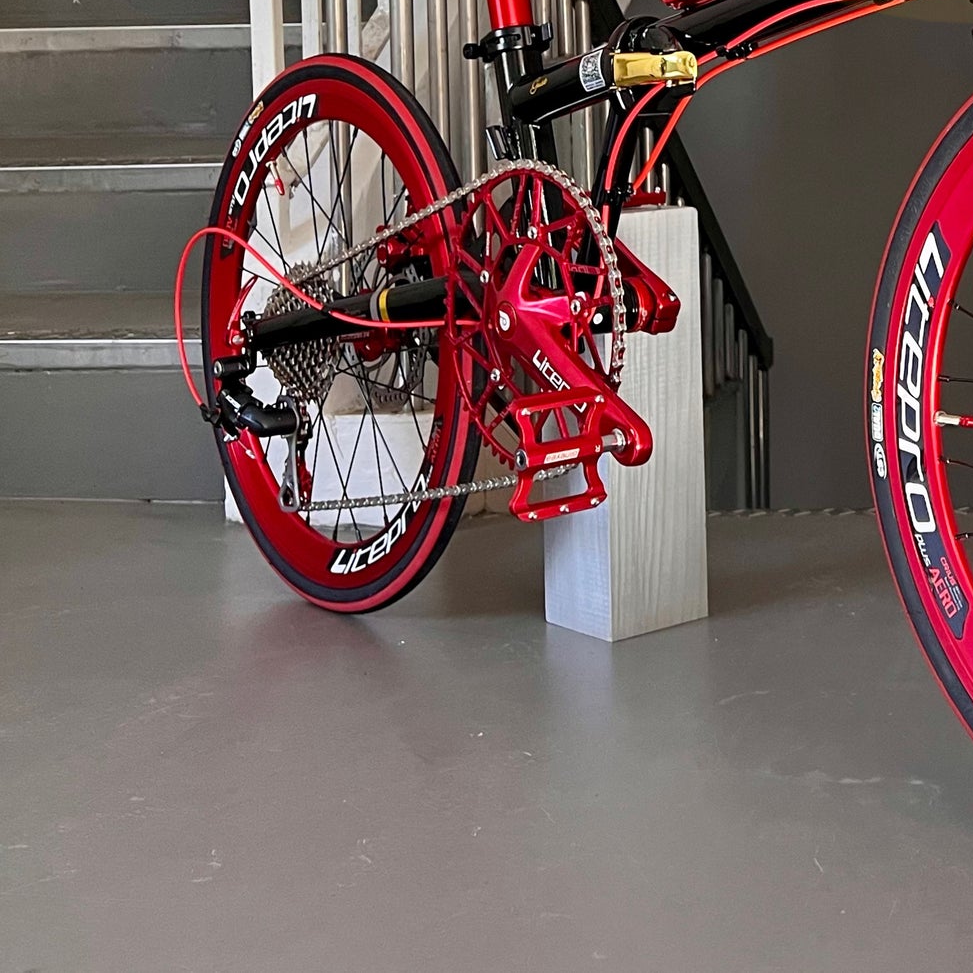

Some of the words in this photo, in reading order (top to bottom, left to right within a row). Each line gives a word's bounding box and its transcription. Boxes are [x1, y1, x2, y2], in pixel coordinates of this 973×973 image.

[234, 93, 317, 207] Litepro
[897, 231, 945, 533] Litepro
[928, 568, 958, 619] AERO
